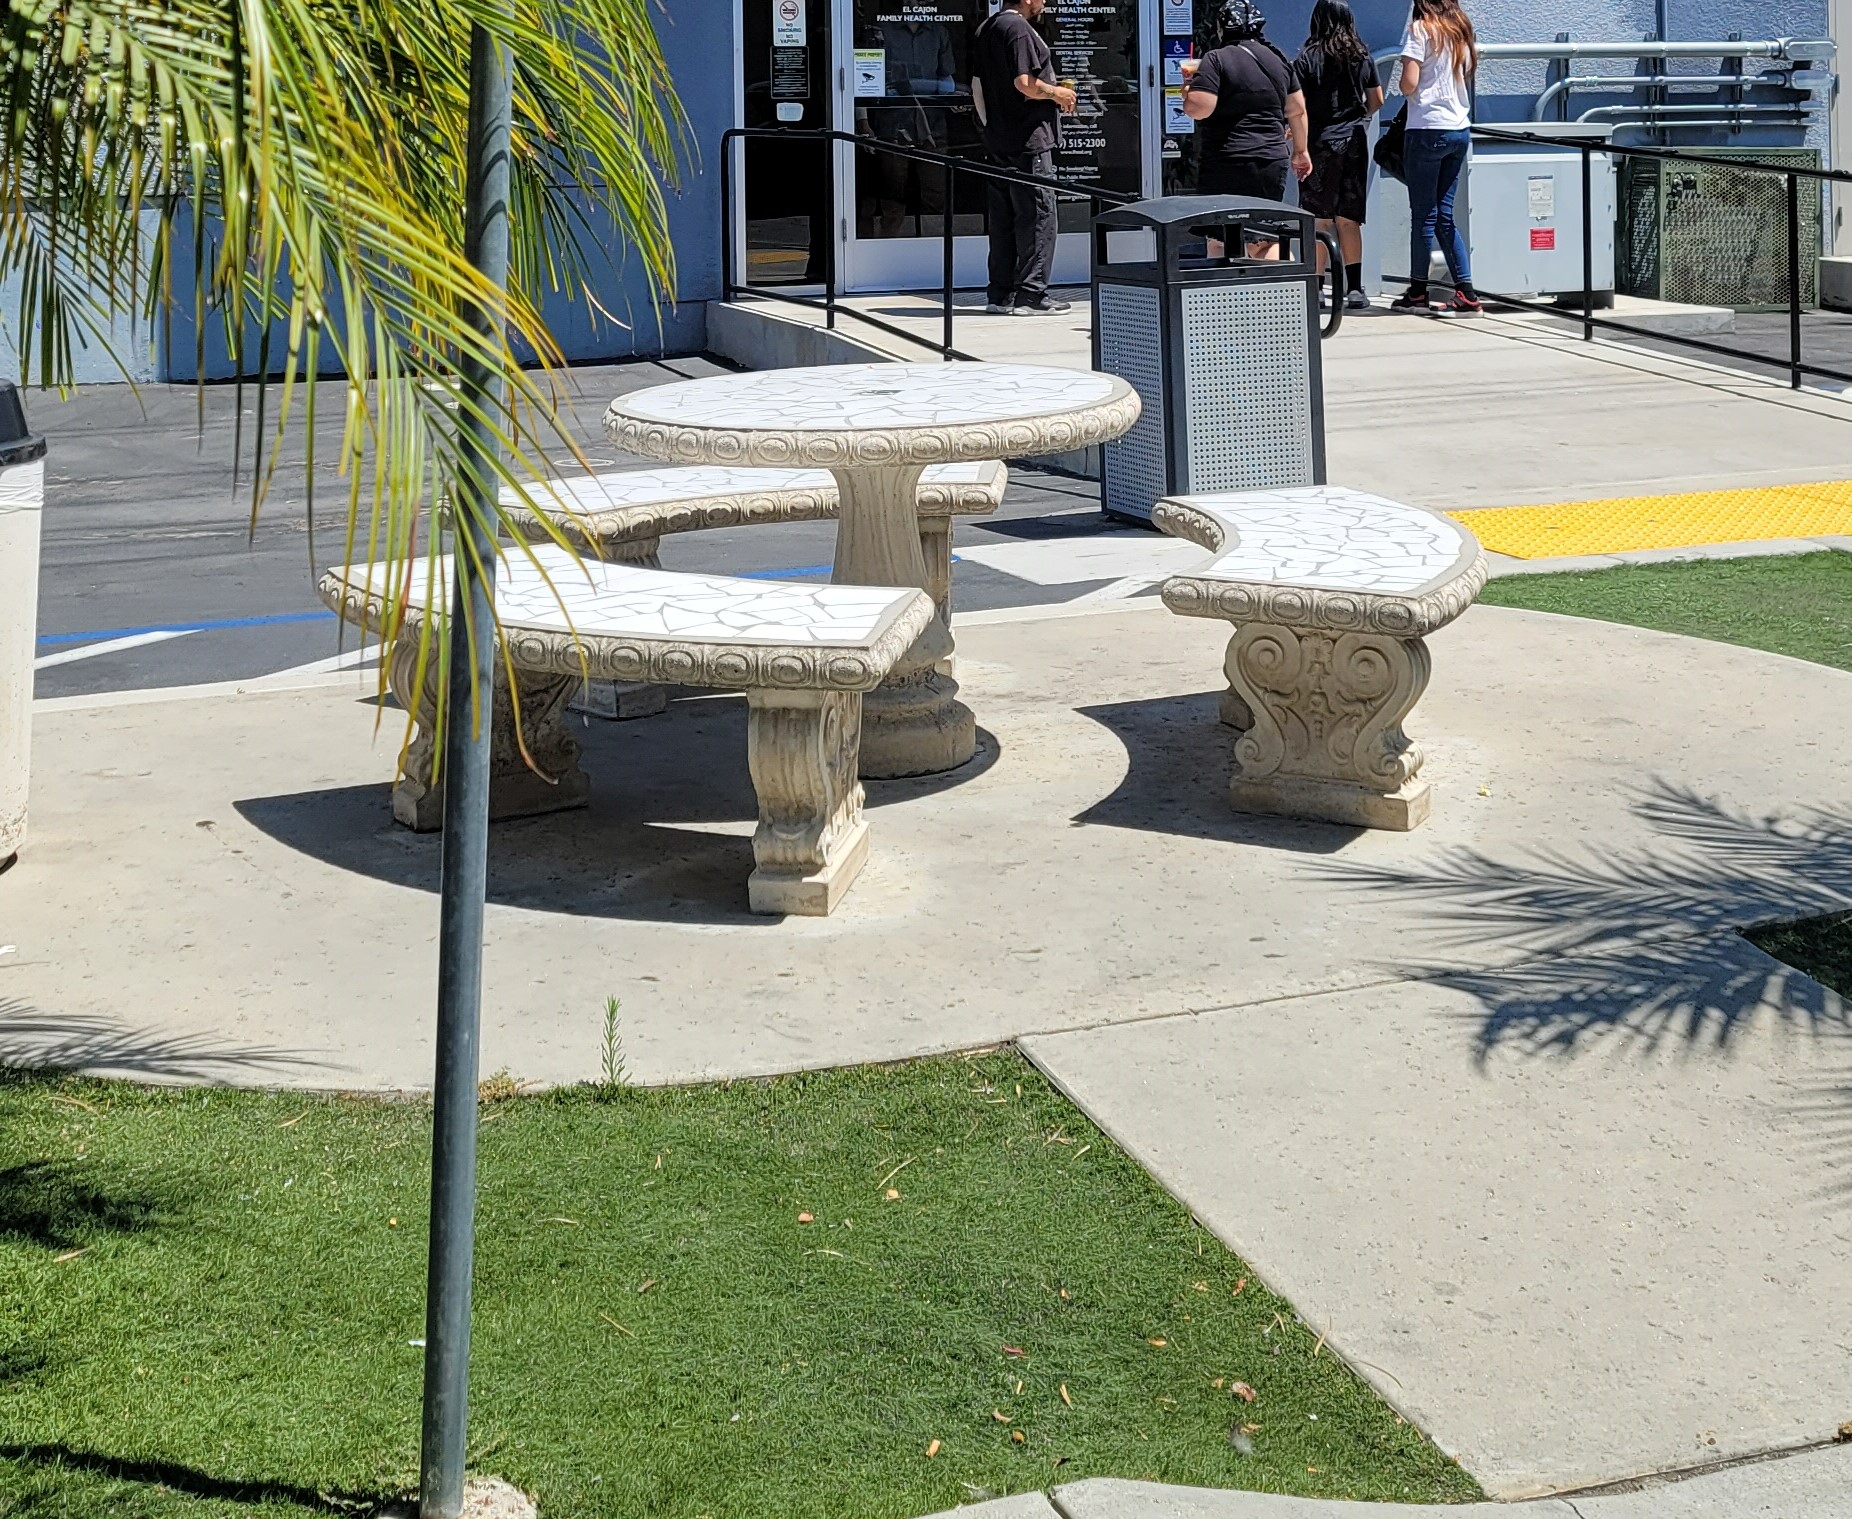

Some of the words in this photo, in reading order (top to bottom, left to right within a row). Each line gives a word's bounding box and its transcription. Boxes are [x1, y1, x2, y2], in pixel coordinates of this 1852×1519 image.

[912, 6, 938, 14] CAJON
[1040, 6, 1057, 14] MILY
[1058, 6, 1087, 14] HEALTH
[1088, 6, 1116, 14] CENTER
[876, 14, 903, 22] FAMILY
[904, 14, 933, 22] HEALTH
[934, 14, 964, 22] CENTER
